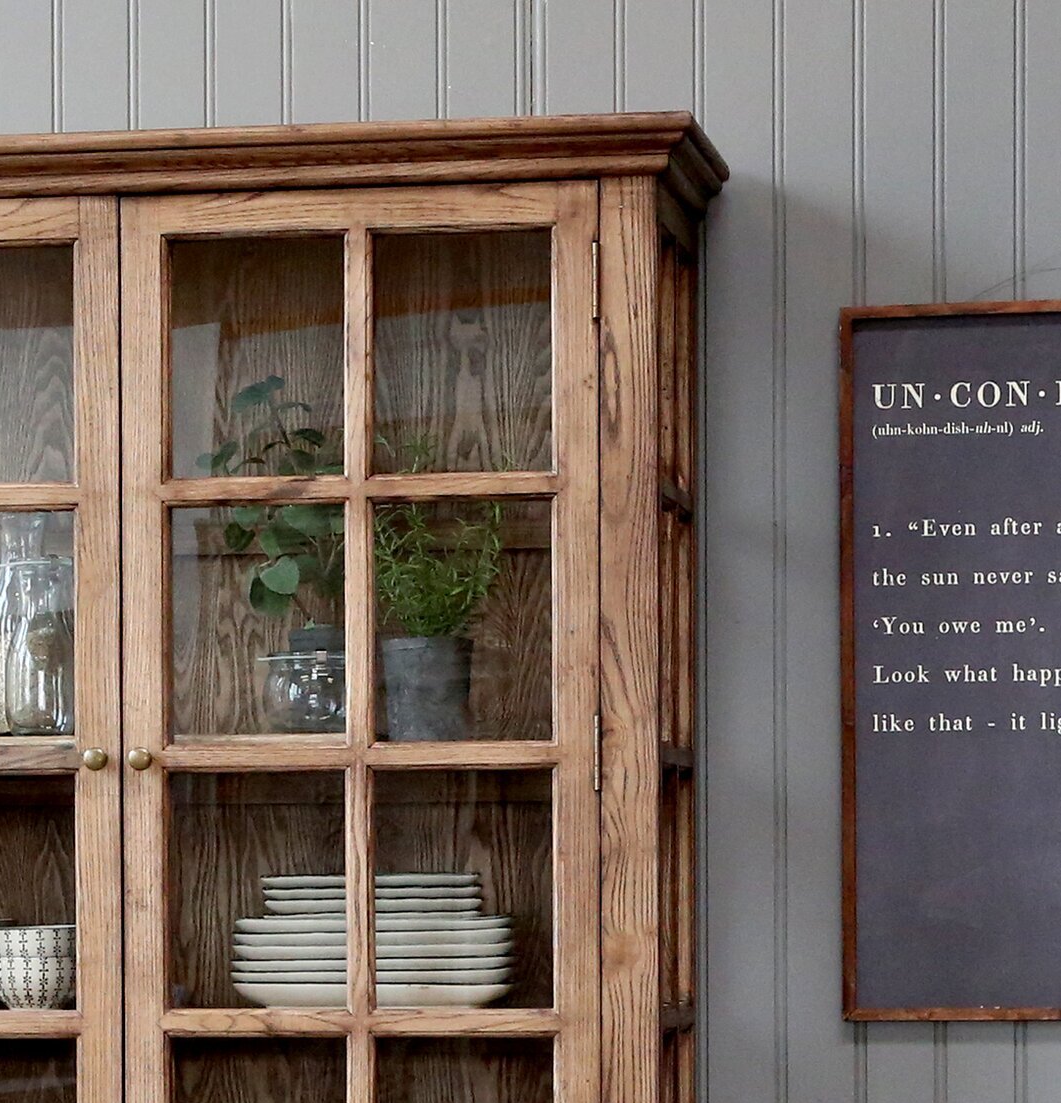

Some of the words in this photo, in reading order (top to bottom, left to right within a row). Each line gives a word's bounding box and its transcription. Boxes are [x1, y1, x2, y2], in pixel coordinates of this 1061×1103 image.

[871, 380, 1061, 410] UN·CON·
[872, 421, 1014, 440] (uhn-kohn-dish-uh-nl)
[1020, 420, 1044, 436] adj.
[872, 525, 892, 538] 1.
[908, 518, 976, 537] “Even
[990, 517, 1043, 536] after
[872, 567, 907, 587] the
[921, 572, 959, 586] sun
[973, 571, 1034, 585] never
[872, 616, 925, 635] ‘You
[938, 620, 981, 634] owe
[995, 617, 1045, 634] me’.
[872, 664, 930, 684] Look
[944, 664, 998, 683] what
[872, 713, 915, 732] like
[929, 712, 973, 732] that
[1010, 712, 1027, 731] it
